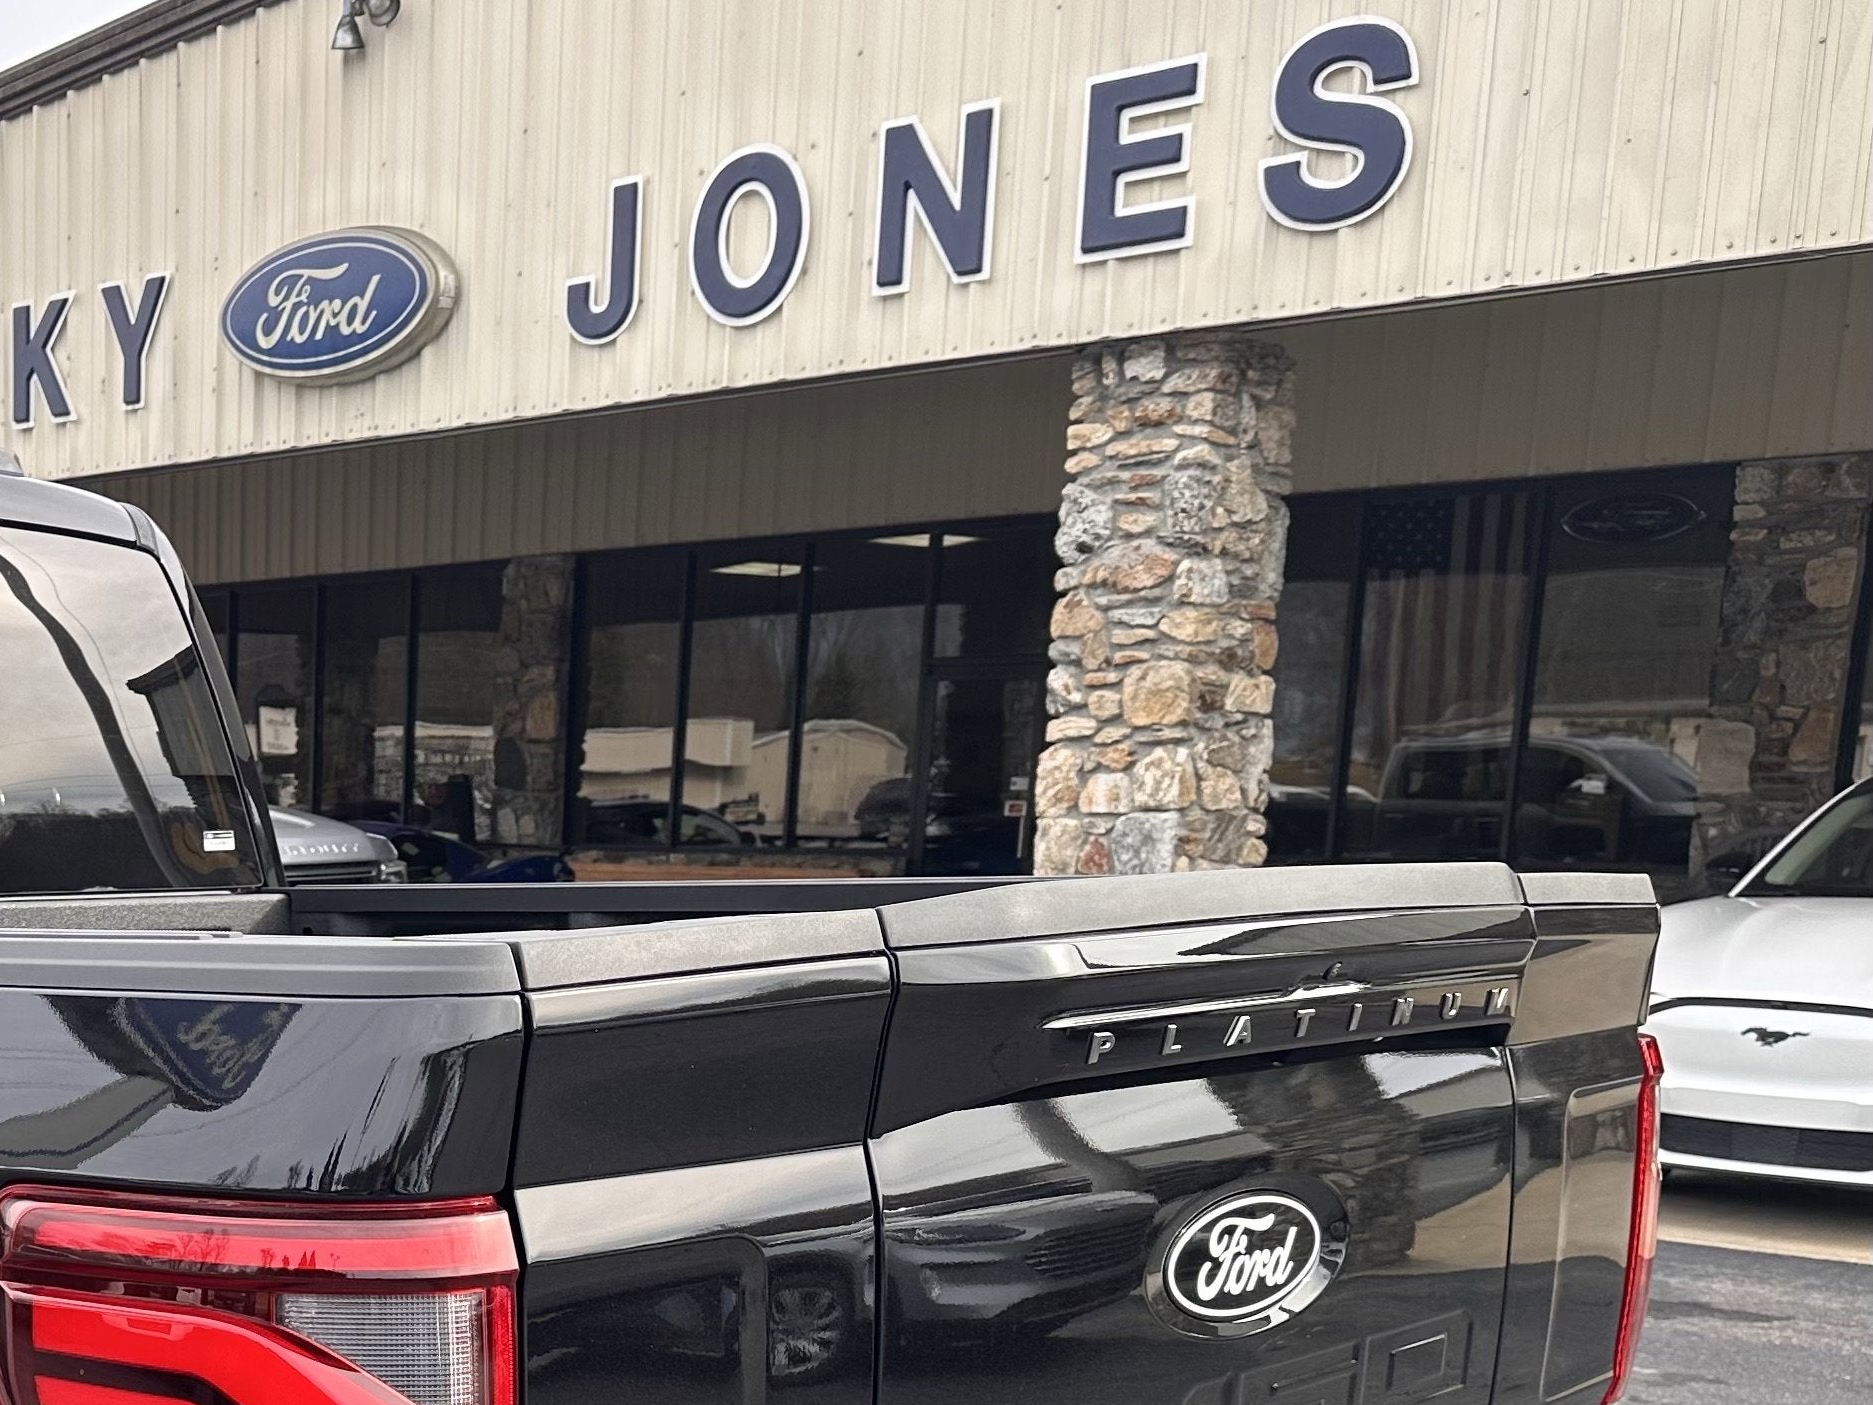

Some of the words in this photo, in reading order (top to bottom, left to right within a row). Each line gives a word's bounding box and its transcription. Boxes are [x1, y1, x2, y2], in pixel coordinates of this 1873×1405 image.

[564, 13, 1422, 346] JONES
[254, 262, 382, 351] Ford
[1085, 988, 1511, 1065] PLATINUM
[1196, 1212, 1295, 1302] Ford
